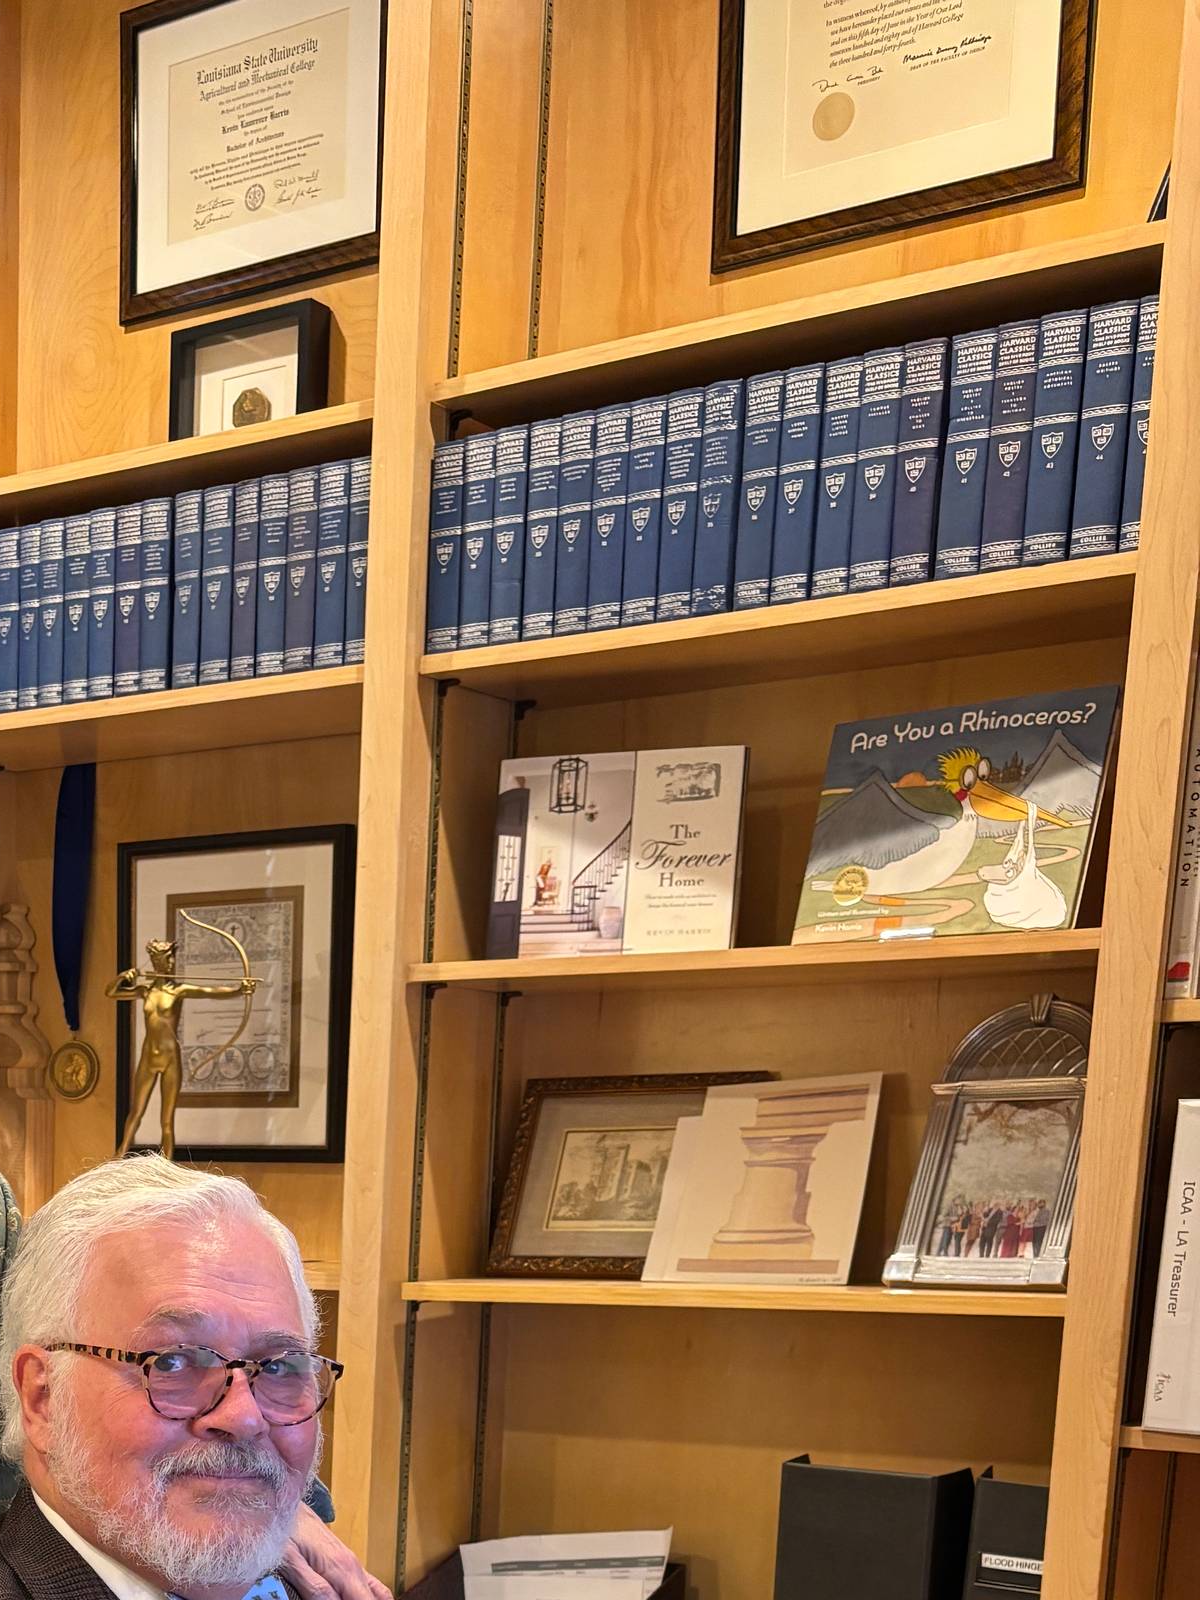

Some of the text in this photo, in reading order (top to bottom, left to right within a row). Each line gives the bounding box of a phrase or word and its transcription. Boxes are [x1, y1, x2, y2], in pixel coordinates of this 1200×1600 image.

[197, 38, 318, 84] Louisiana State University
[200, 81, 236, 101] Agricultural
[238, 79, 250, 89] and
[251, 66, 288, 85] Mechanical
[290, 60, 315, 74] College
[1094, 316, 1131, 329] HARVARD
[1044, 326, 1081, 338] HARVARD
[1093, 324, 1130, 336] CLASSICS
[1000, 336, 1036, 348] HARVARD
[1044, 334, 1080, 346] CLASSICS
[958, 345, 993, 356] HARVARD
[1000, 344, 1035, 356] CLASSICS
[907, 355, 942, 366] HARVARD
[957, 352, 992, 363] CLASSICS
[866, 363, 900, 374] HARVARD
[907, 362, 941, 373] CLASSICS
[828, 372, 860, 383] HARVARD
[865, 370, 899, 381] CLASSICS
[787, 380, 817, 390] HARVARD
[827, 379, 859, 391] CLASSICS
[749, 387, 779, 397] HARVARD
[786, 386, 816, 398] CLASSICS
[749, 394, 779, 405] CLASSICS
[669, 404, 699, 415] HARVARD
[633, 411, 662, 422] HARVARD
[669, 411, 698, 422] CLASSICS
[632, 418, 661, 429] CLASSICS
[1080, 535, 1106, 543] COLLIER
[989, 550, 1014, 558] COLLIER
[851, 702, 1097, 754] Are You a Rhinoceros?
[670, 824, 701, 839] The
[635, 840, 732, 870] Forever
[659, 872, 704, 887] Home
[1182, 1181, 1196, 1216] ICAA
[1176, 1230, 1190, 1248] LA
[1167, 1252, 1187, 1318] Treasurer
[984, 1557, 1014, 1568] FLOOD
